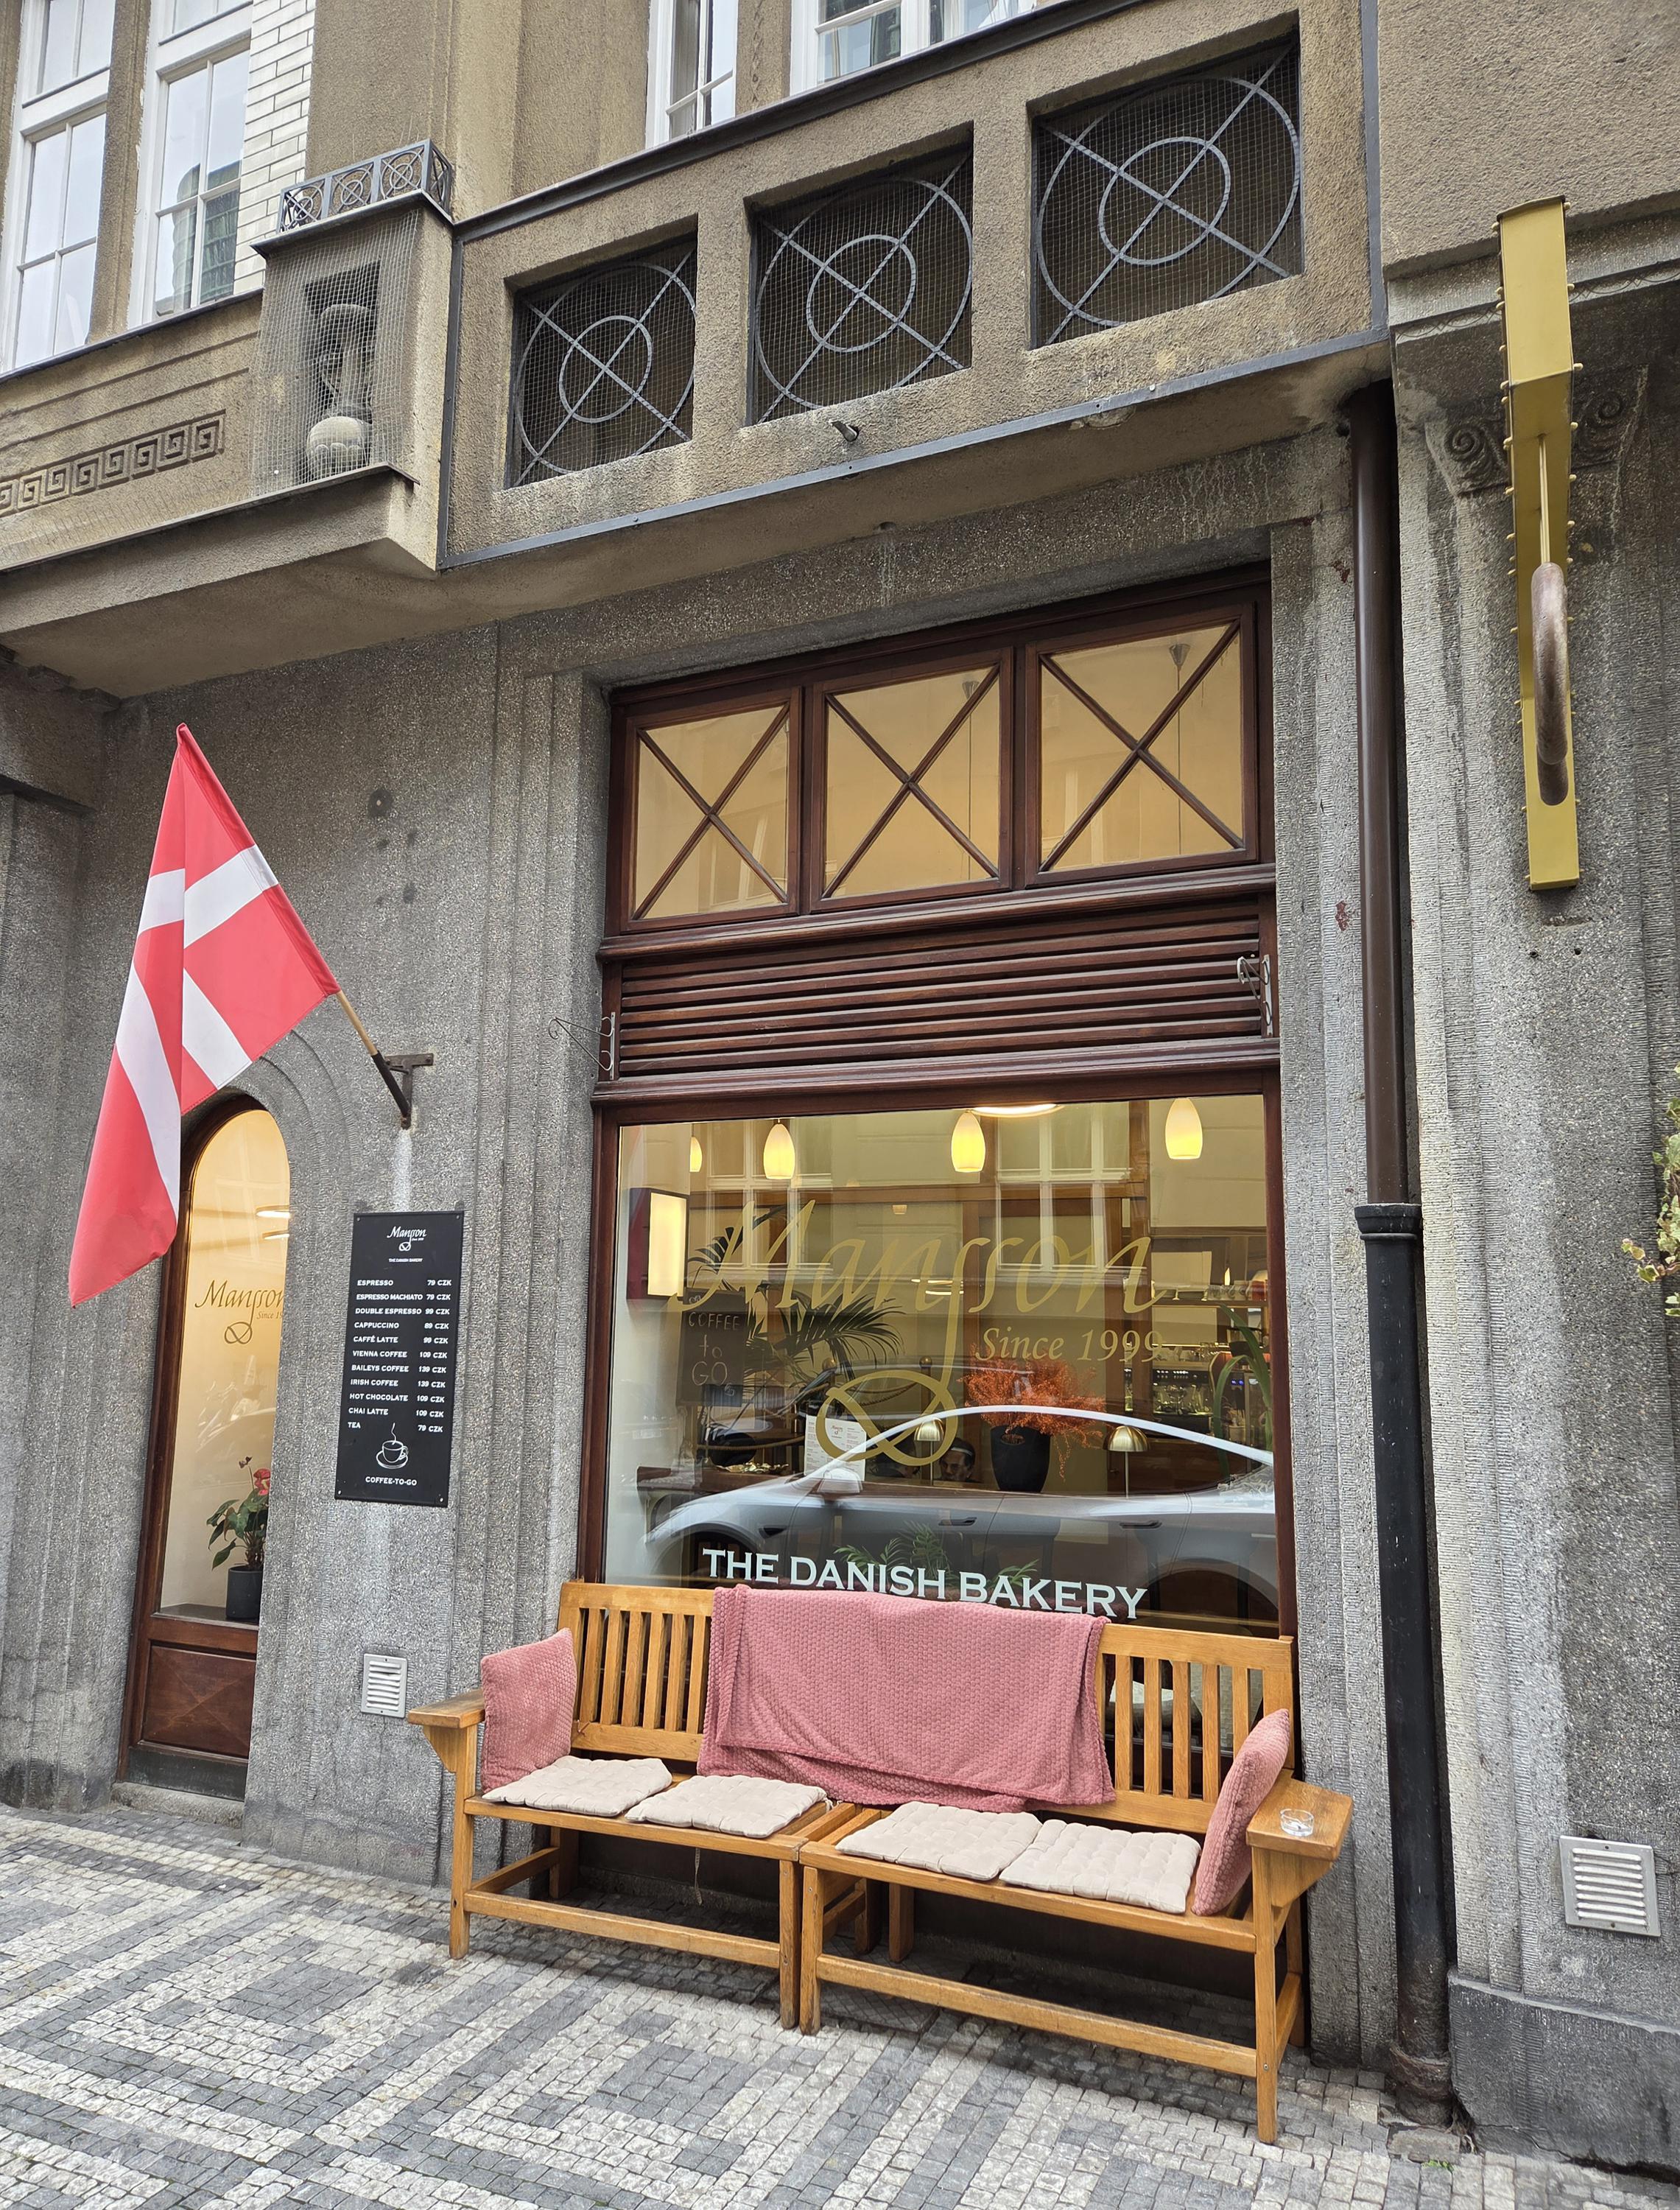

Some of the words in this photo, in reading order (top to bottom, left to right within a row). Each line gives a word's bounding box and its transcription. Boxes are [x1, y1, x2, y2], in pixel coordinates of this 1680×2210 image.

[256, 1311, 273, 1319] Since
[689, 1311, 740, 1331] COFFEE
[699, 1334, 723, 1358] to
[975, 1327, 1064, 1361] Since
[1077, 1329, 1163, 1363] 1999
[692, 1361, 728, 1386] GO
[365, 1476, 417, 1485] COFFEE-TO-GO
[703, 1548, 779, 1584] THE
[790, 1556, 946, 1599] DANISH
[959, 1571, 1147, 1619] BAKERY
